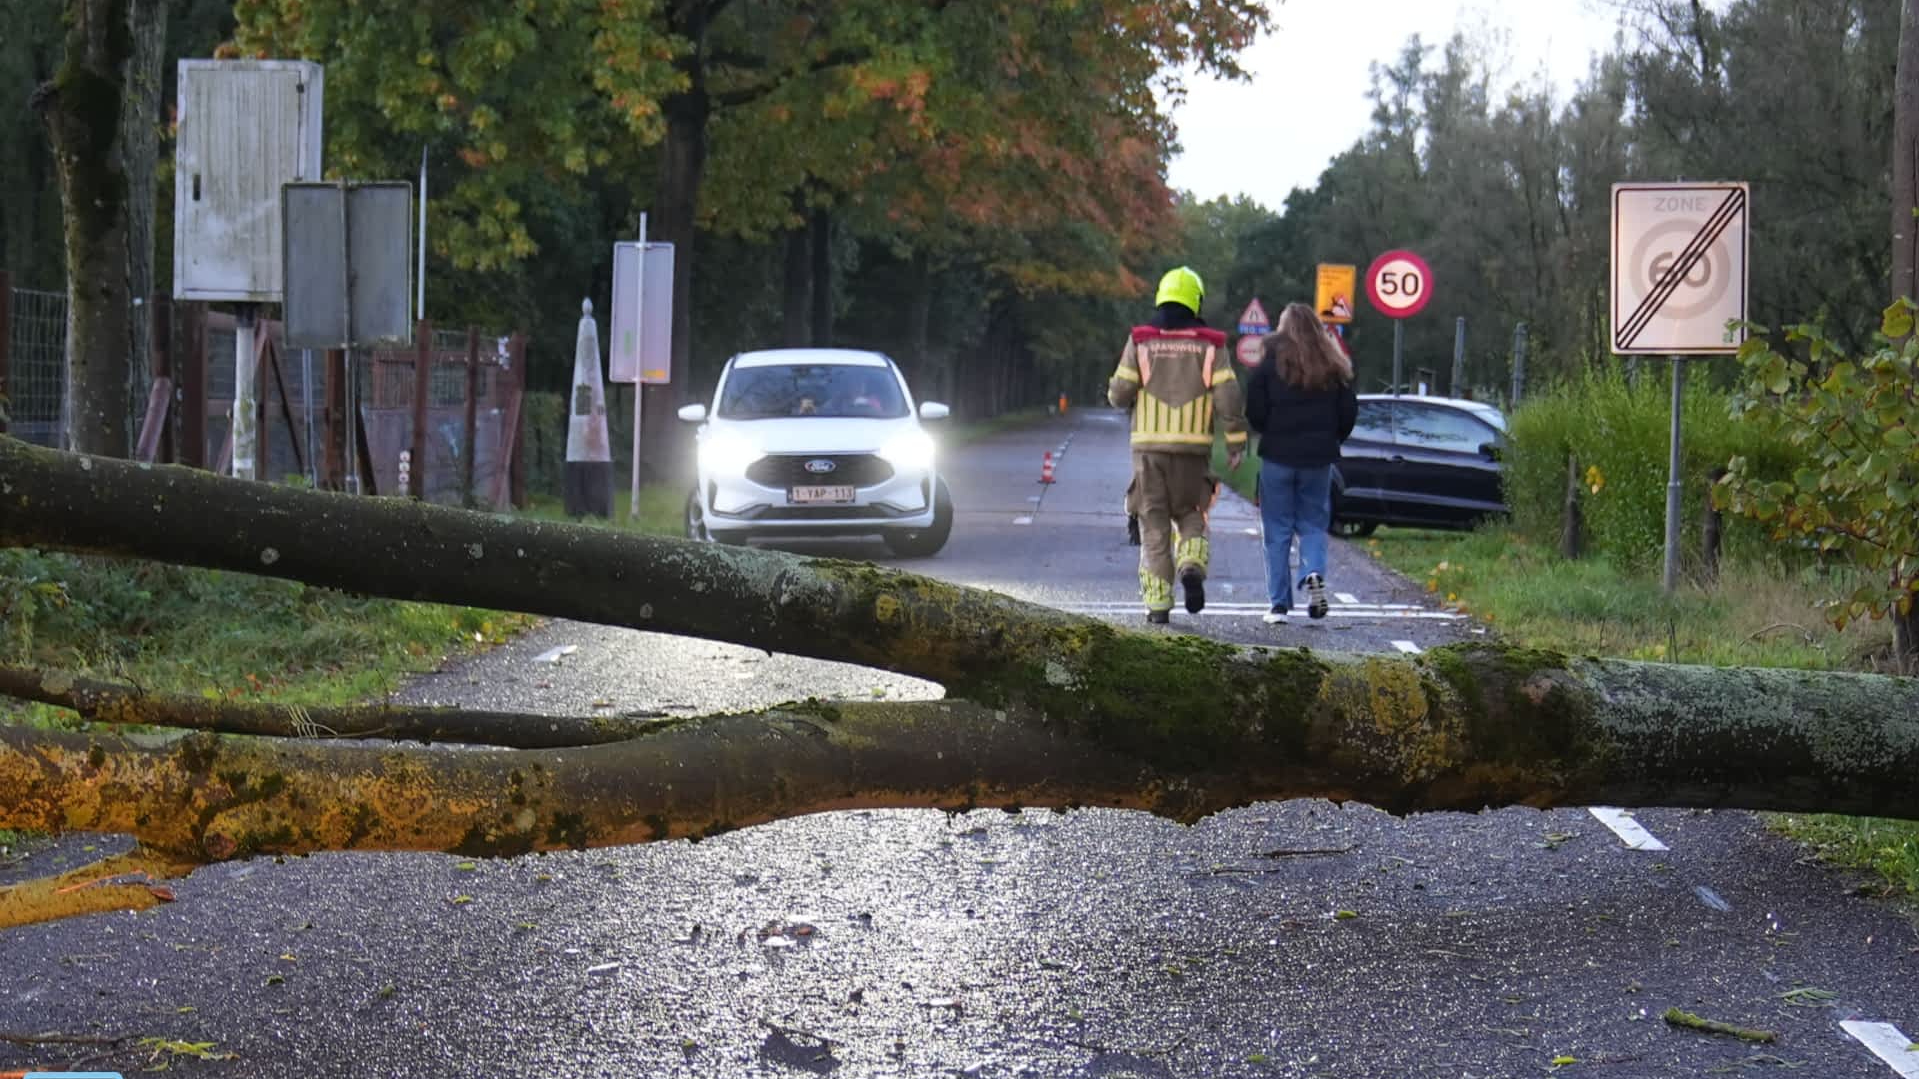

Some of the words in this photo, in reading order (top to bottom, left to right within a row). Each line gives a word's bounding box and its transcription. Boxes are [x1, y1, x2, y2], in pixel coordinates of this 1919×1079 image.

[1654, 197, 1706, 212] ZONE
[1648, 251, 1711, 287] 60
[1381, 272, 1419, 296] 50
